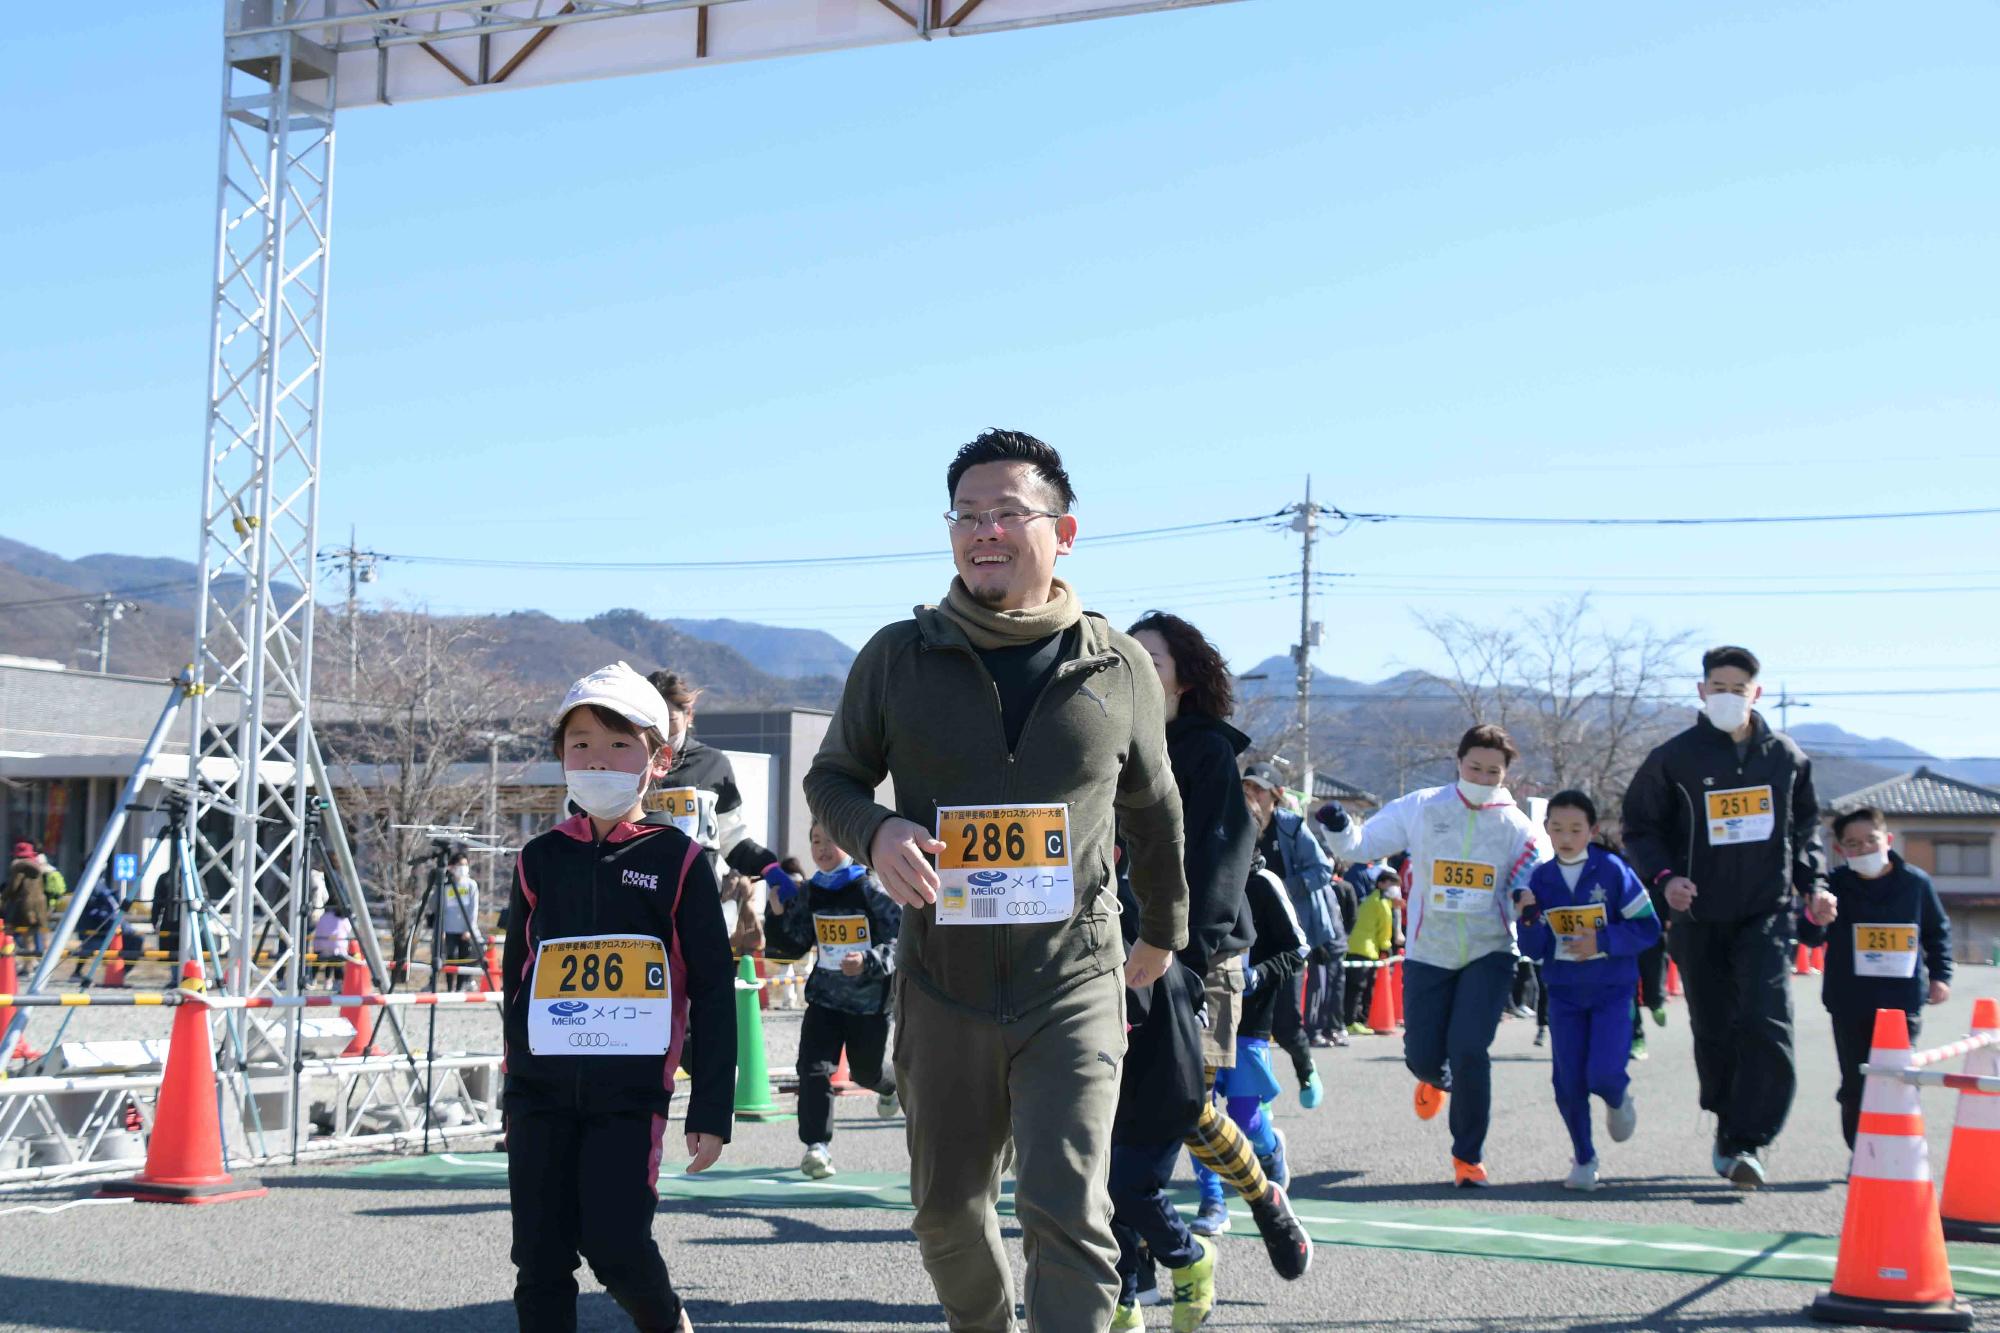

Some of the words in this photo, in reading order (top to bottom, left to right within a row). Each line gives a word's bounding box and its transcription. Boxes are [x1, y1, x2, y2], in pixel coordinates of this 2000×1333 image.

[1721, 796, 1749, 815] 251
[962, 822, 1025, 862] 286
[1047, 835, 1061, 854] C
[622, 869, 659, 890] NIKE
[1011, 875, 1069, 888] メイコー
[1444, 866, 1474, 885] 355
[971, 887, 1006, 896] MEIKO
[821, 923, 847, 942] 359
[1868, 931, 1897, 949] 251
[559, 953, 623, 991] 286
[648, 967, 662, 986] C
[552, 1017, 586, 1026] MEIKO
[592, 1006, 652, 1020] メイコー
